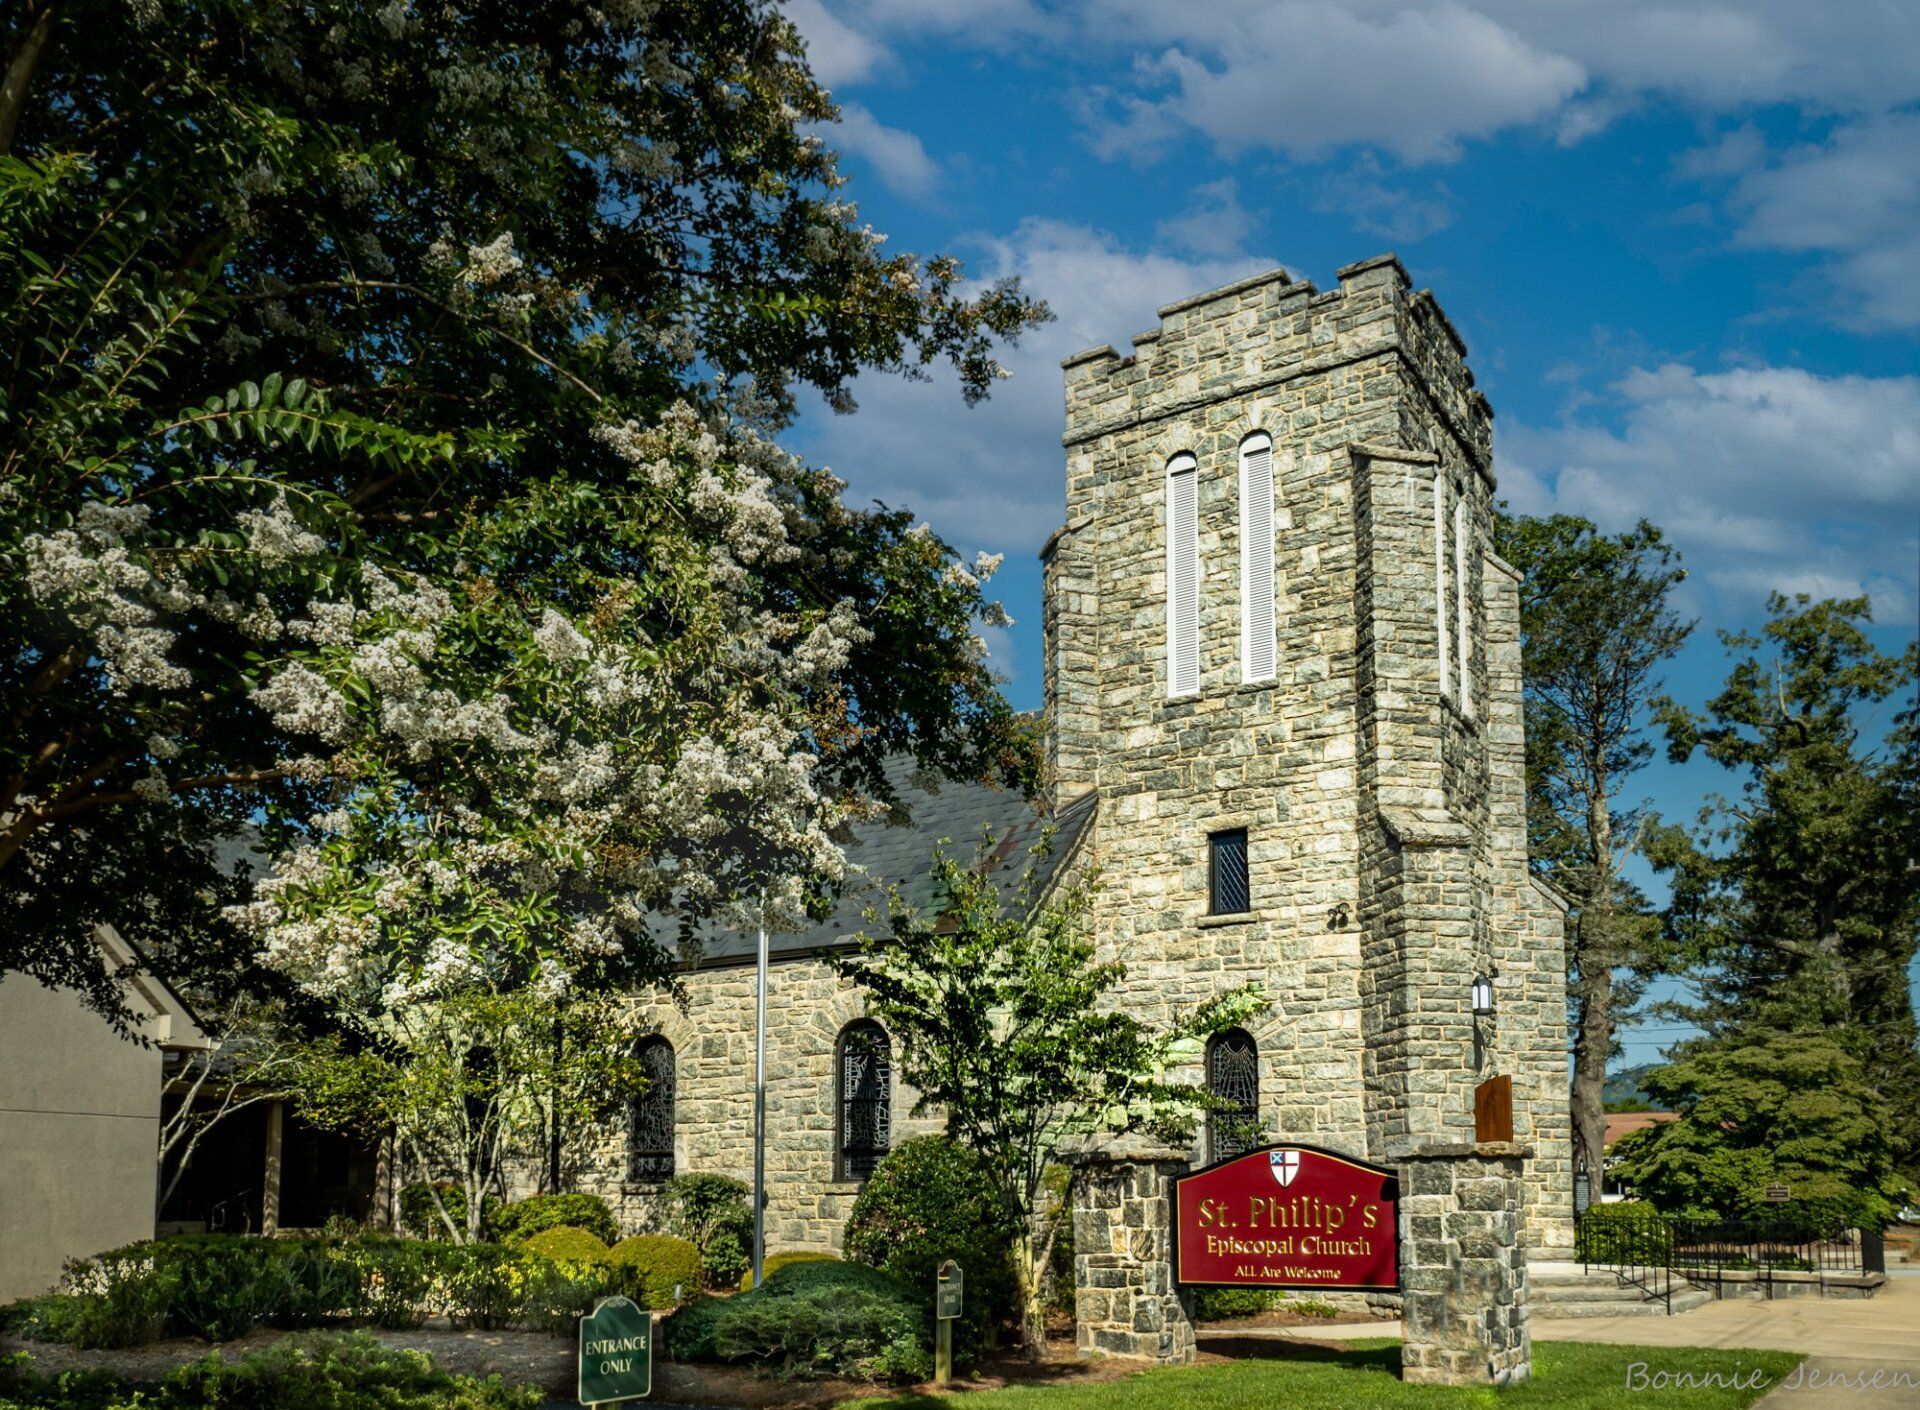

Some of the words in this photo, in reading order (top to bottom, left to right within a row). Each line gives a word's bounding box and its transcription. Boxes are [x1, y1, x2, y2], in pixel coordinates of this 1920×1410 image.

[1199, 1197, 1238, 1229] St.
[1249, 1195, 1378, 1234] Philip's
[1207, 1234, 1294, 1257] Episcopal
[1300, 1235, 1371, 1256] Church
[1260, 1265, 1282, 1278] Are
[1284, 1265, 1341, 1279] Welcome
[585, 1336, 647, 1356] ENTRANCE
[600, 1358, 632, 1375] ONLY
